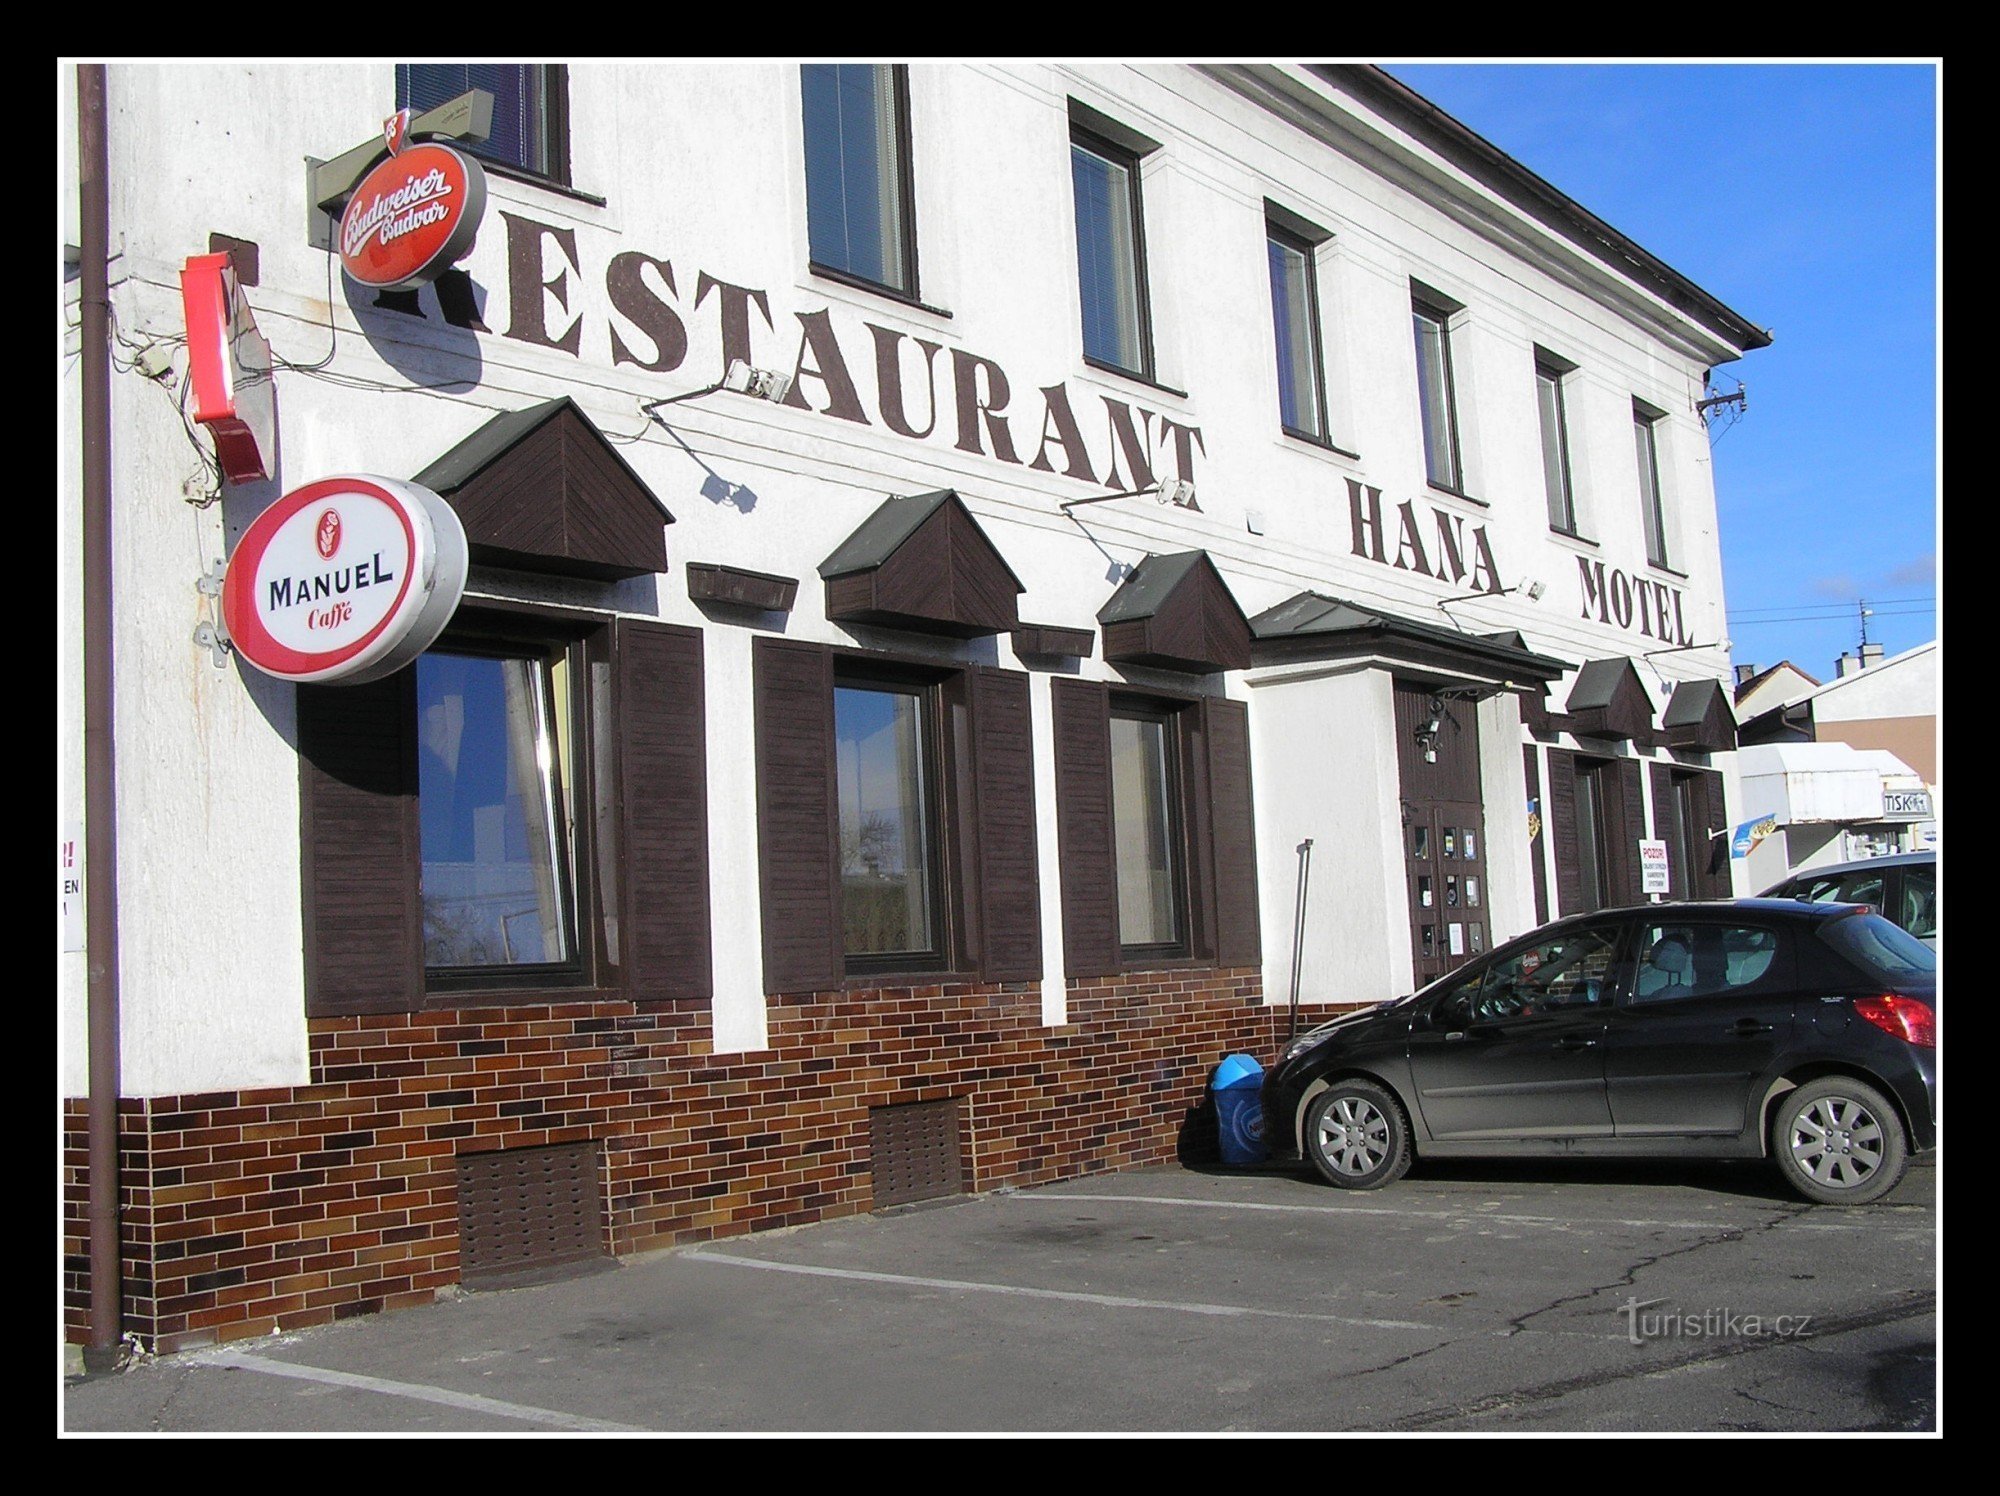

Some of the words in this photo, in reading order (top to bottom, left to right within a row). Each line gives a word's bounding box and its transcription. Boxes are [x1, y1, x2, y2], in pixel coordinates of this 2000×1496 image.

[345, 168, 452, 256] Budweiser
[380, 201, 449, 245] Budvar
[269, 552, 393, 611] MANUEL
[1343, 476, 1505, 596] HANA
[1575, 554, 1694, 649] MOTEL
[308, 601, 352, 630] Caffé
